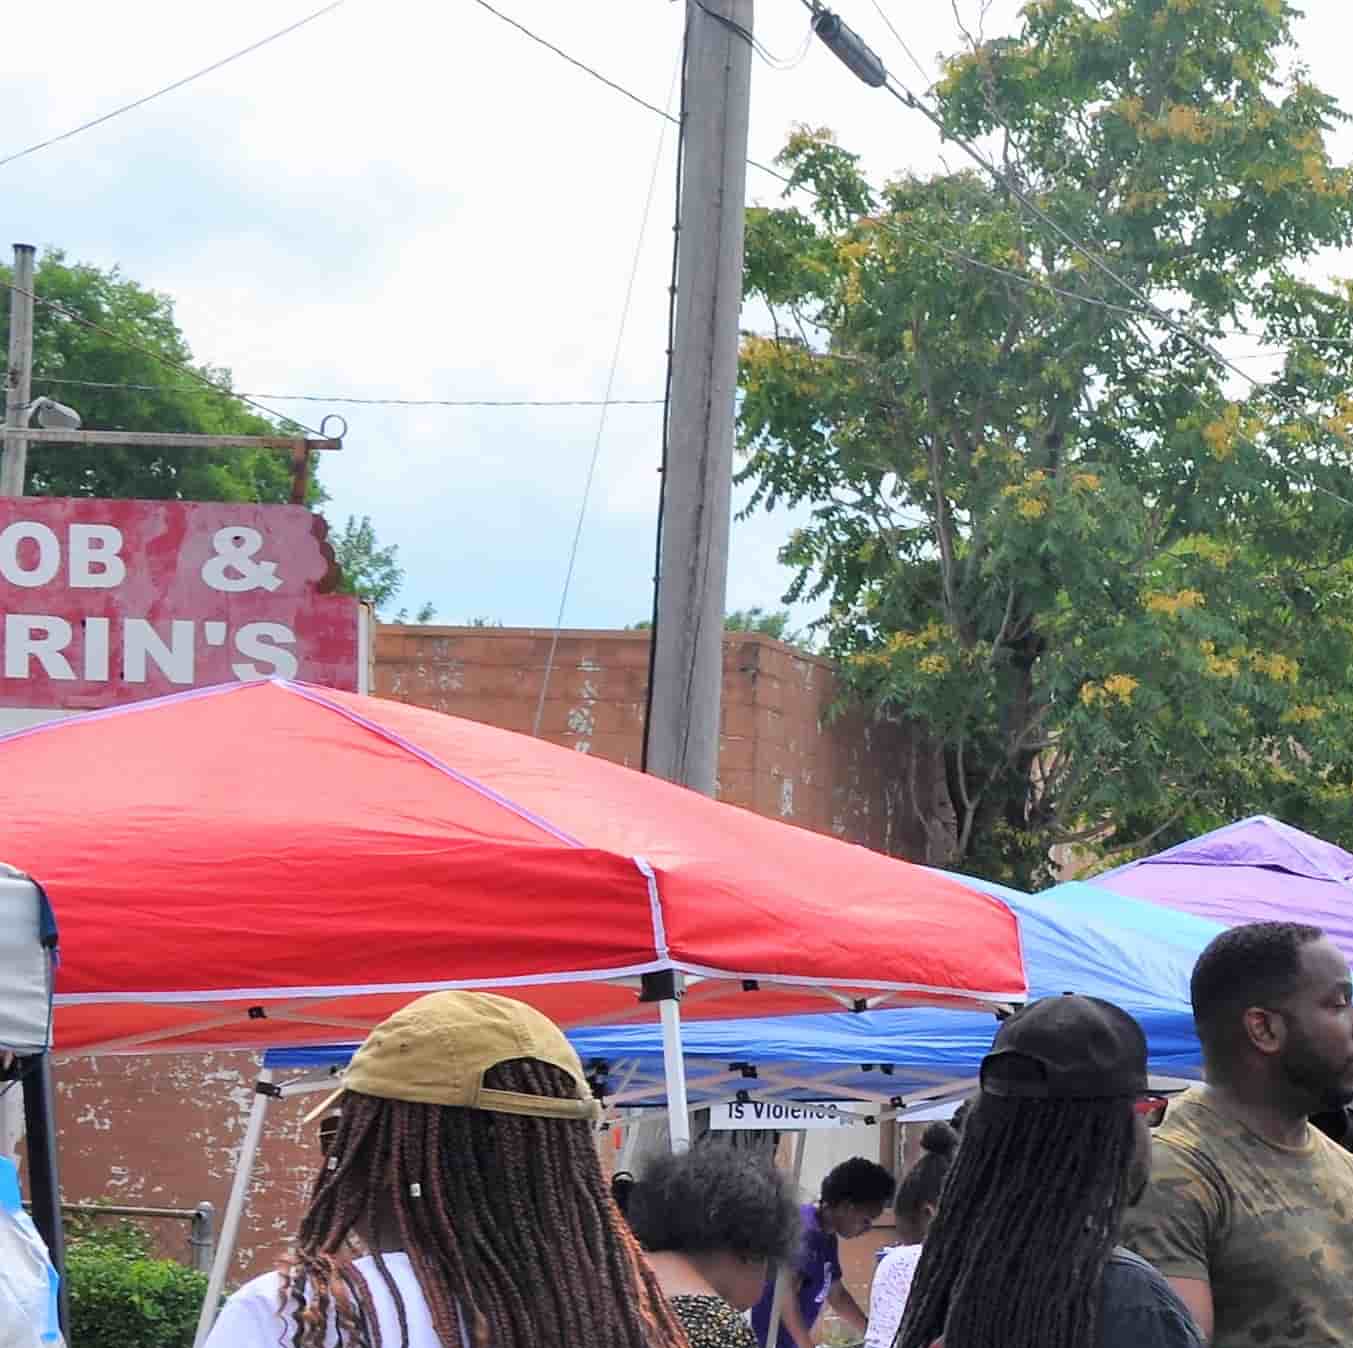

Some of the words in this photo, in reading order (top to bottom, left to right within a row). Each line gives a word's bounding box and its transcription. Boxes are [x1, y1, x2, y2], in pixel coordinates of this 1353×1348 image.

[0, 521, 127, 588] OB
[201, 526, 284, 592] &
[3, 613, 299, 685] RIN'S
